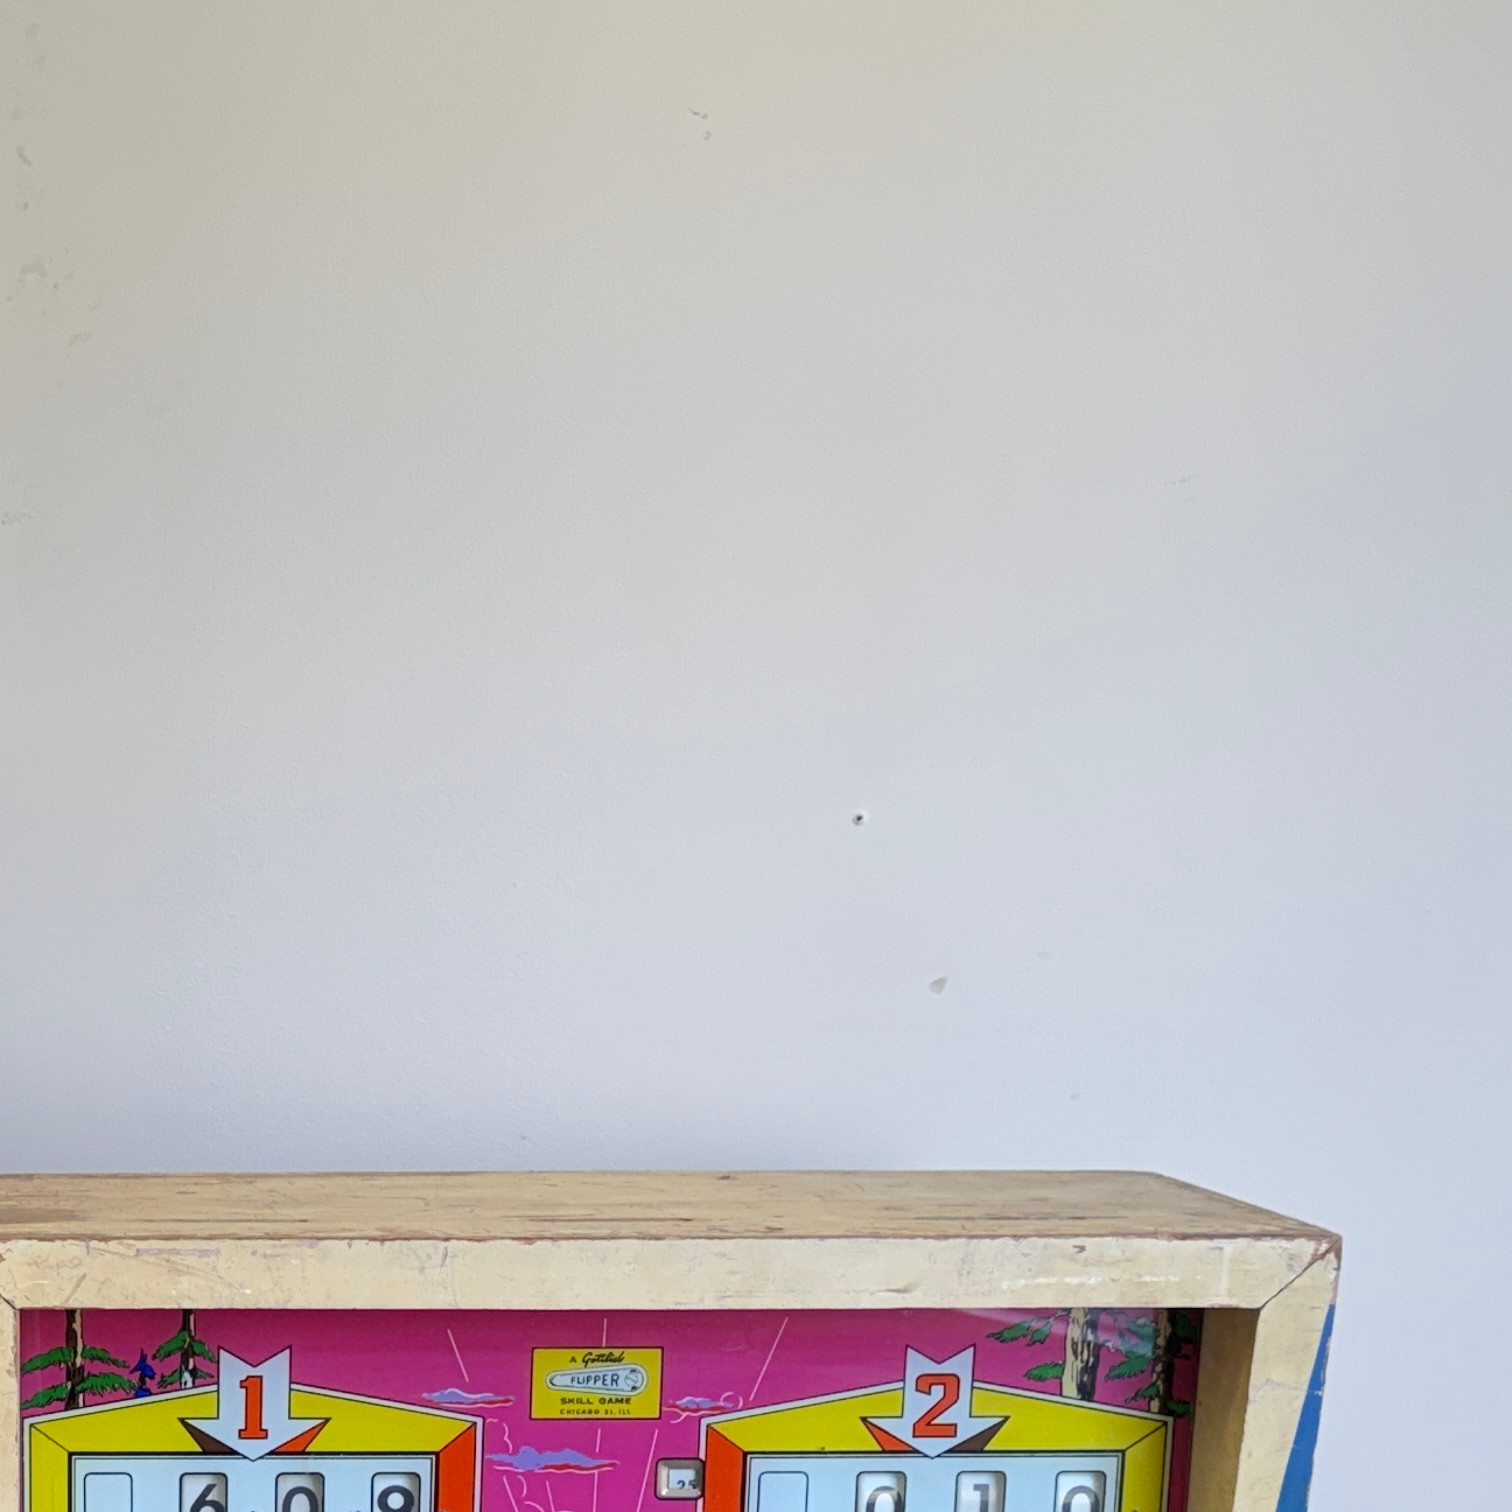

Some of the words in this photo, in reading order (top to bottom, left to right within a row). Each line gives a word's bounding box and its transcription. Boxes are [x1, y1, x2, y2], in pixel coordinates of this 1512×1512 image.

[582, 1351, 625, 1368] Gottlieb
[571, 1373, 620, 1387] FLIPPER
[238, 1375, 269, 1440] 1
[560, 1397, 593, 1405] SKILL
[599, 1397, 631, 1405] GAME
[912, 1372, 960, 1438] 2
